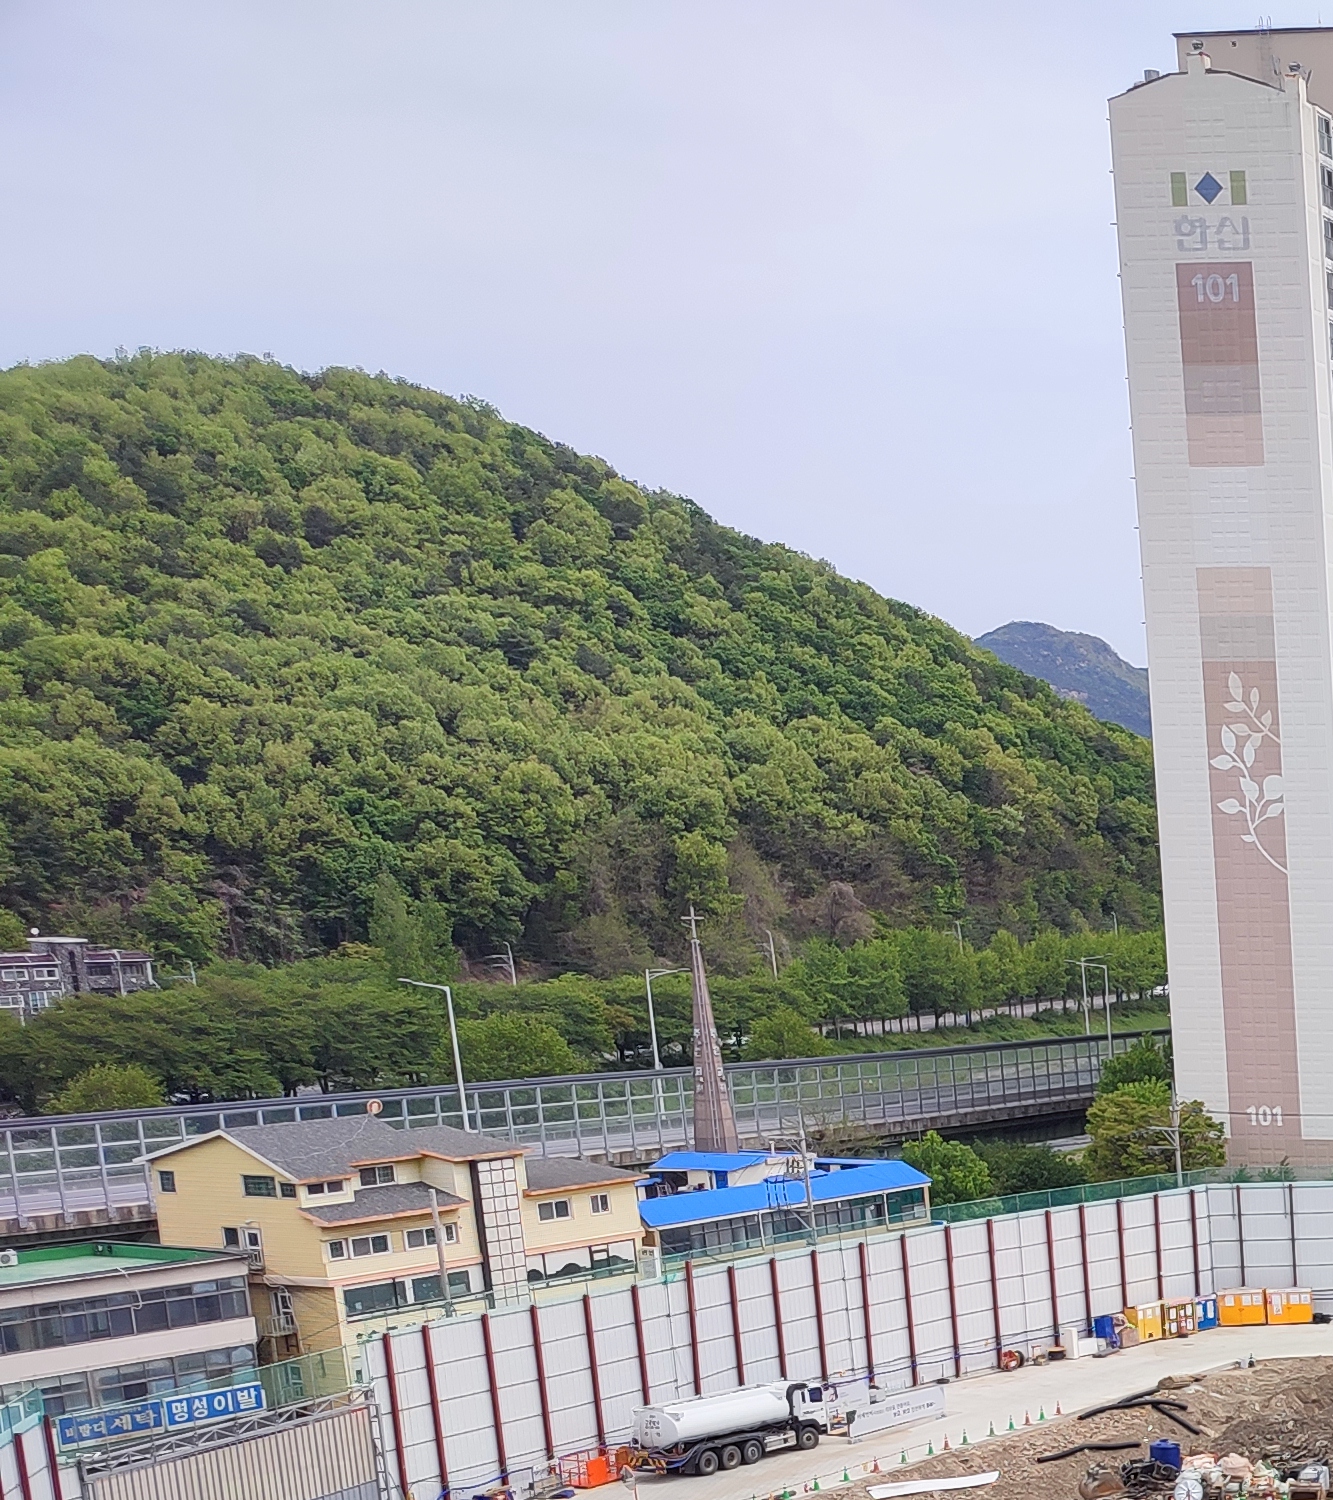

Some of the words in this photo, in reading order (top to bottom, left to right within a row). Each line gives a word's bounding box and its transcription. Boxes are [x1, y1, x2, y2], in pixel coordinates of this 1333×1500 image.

[1173, 215, 1250, 251] 한신
[1191, 273, 1239, 302] 101
[1246, 1105, 1283, 1127] 101
[110, 1408, 158, 1431] 세탁
